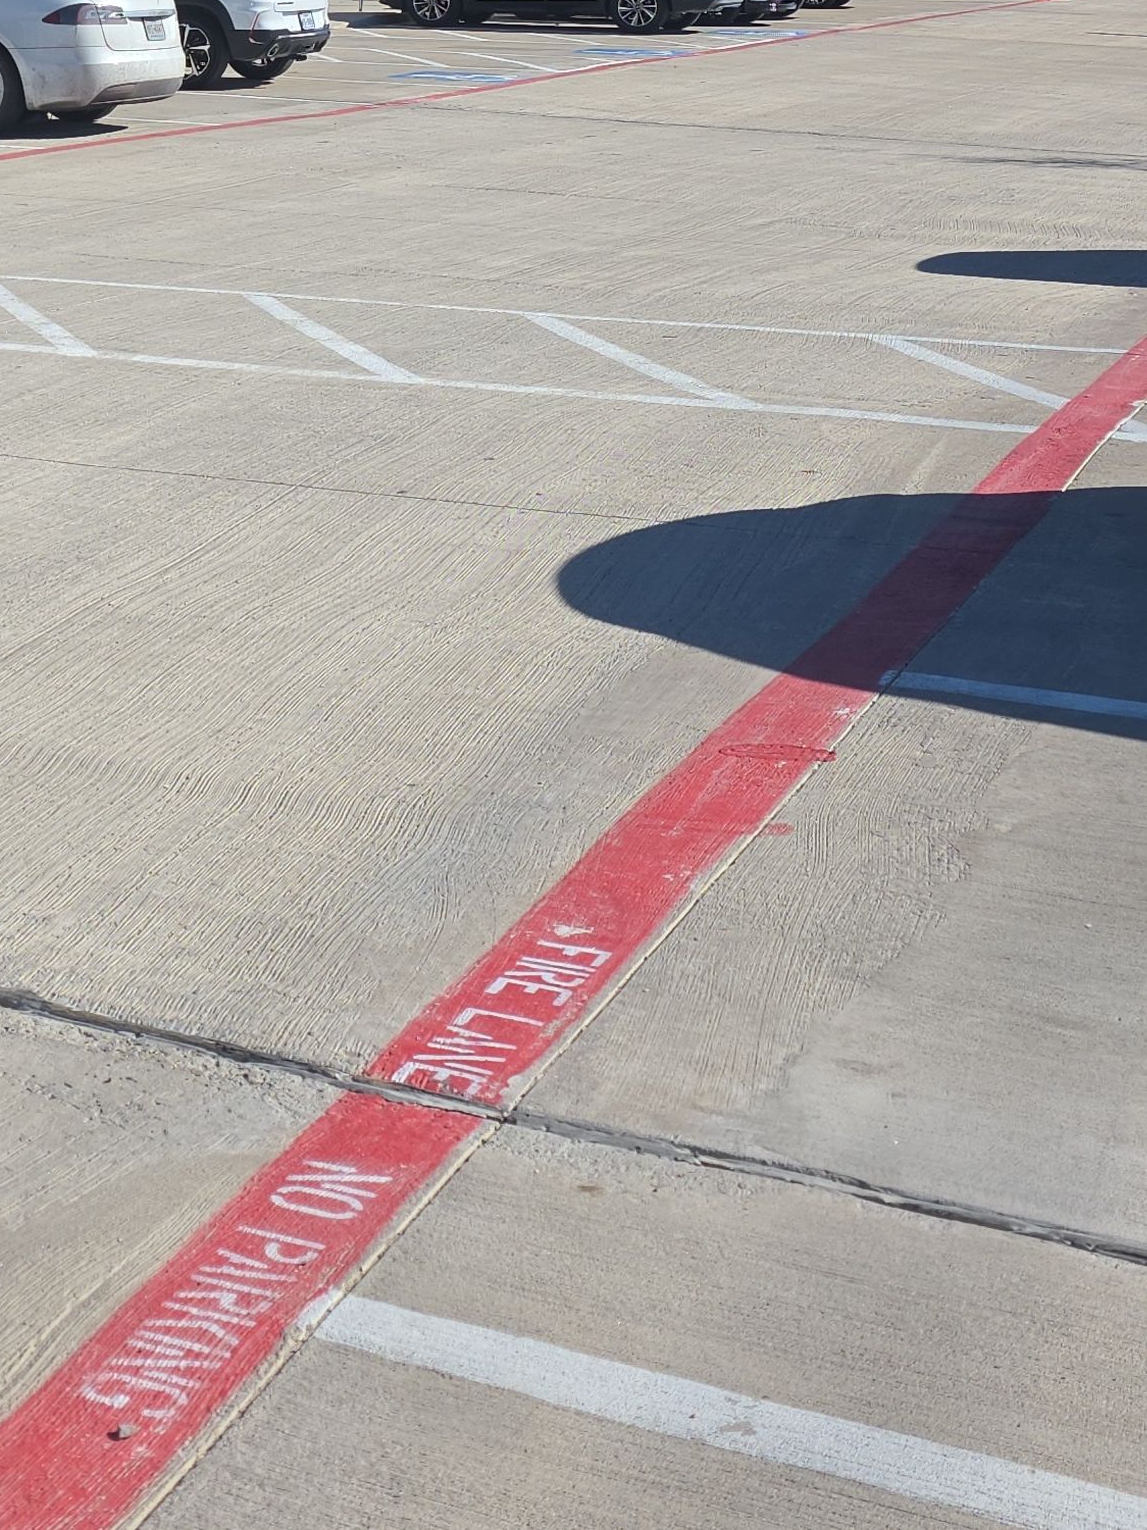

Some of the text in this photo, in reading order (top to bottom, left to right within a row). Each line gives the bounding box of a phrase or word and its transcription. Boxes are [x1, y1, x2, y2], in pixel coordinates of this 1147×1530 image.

[80, 938, 613, 1420] FIRE LANE NO PARKING
